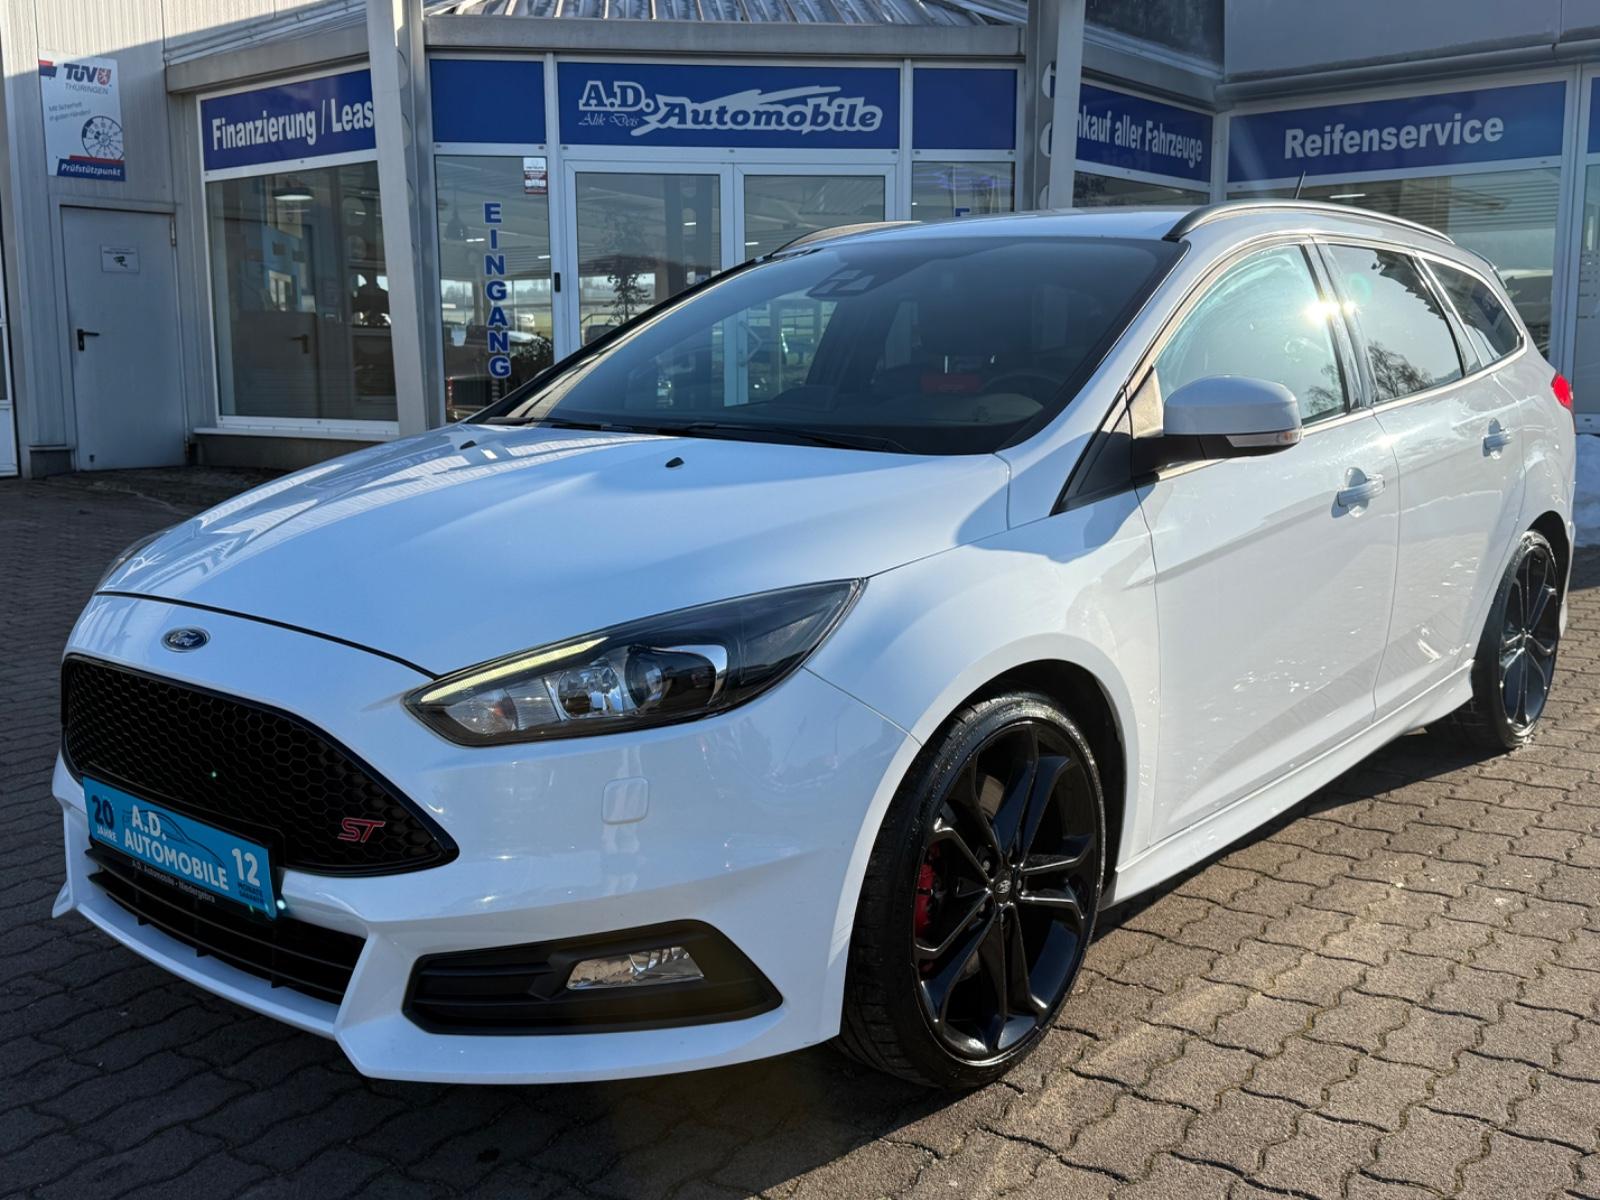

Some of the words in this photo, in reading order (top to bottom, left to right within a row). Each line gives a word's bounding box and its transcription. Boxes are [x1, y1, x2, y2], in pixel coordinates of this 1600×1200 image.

[64, 63, 98, 82] TÜV
[65, 83, 109, 94] THÜRINGEN
[211, 109, 317, 151] Finanzierung
[320, 99, 326, 135] /
[578, 80, 655, 112] A.D.
[654, 95, 883, 135] Automobile
[1114, 114, 1143, 150] aller
[1145, 120, 1203, 168] Fahrzeuge
[1284, 112, 1504, 159] Reifenservice
[61, 163, 121, 177] Prüfstützpunkt
[484, 202, 512, 379] EINGANG
[91, 795, 114, 830] 20
[131, 805, 167, 841] A.D.
[337, 817, 386, 843] ST
[97, 825, 117, 842] JAHRE
[124, 828, 229, 891] AUTOMOBILE
[231, 848, 260, 886] 12
